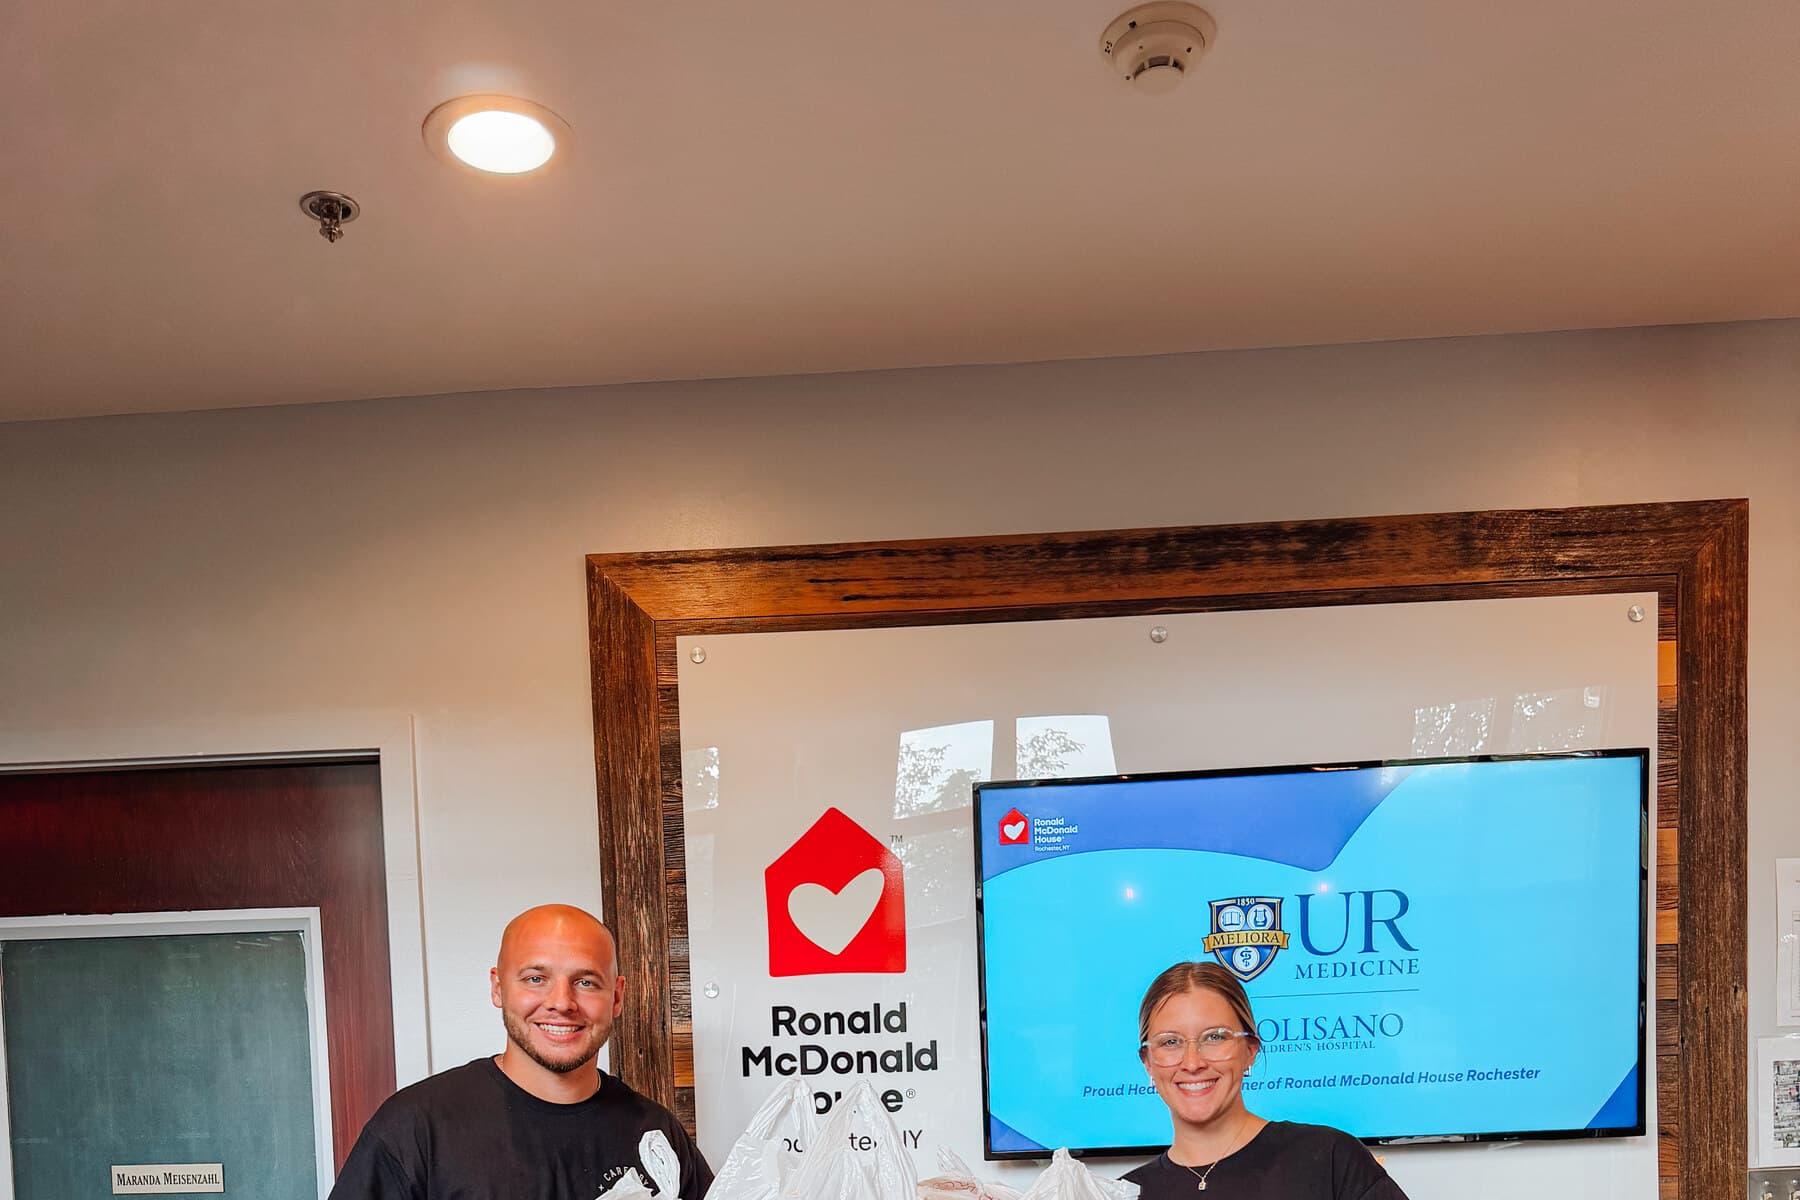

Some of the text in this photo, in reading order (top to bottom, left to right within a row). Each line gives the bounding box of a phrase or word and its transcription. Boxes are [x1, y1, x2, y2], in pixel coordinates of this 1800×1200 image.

[1033, 817, 1064, 826] Ronald
[1033, 825, 1078, 835] McDonald
[1034, 836, 1062, 844] House
[1236, 898, 1255, 906] 1850
[1294, 889, 1419, 956] UR
[1212, 931, 1280, 947] MELIORA
[1295, 958, 1420, 980] MEDICINE
[772, 1002, 907, 1037] Ronald
[1257, 1012, 1404, 1043] OLISANO
[1317, 1041, 1376, 1051] HOSPITAL
[742, 1040, 938, 1077] McDonald
[1083, 1083, 1124, 1097] Proud
[1267, 1077, 1283, 1090] of
[1284, 1075, 1336, 1089] Ronald
[1339, 1072, 1414, 1087] McDonald
[1418, 1071, 1463, 1084] House
[1466, 1067, 1541, 1082] Rochester
